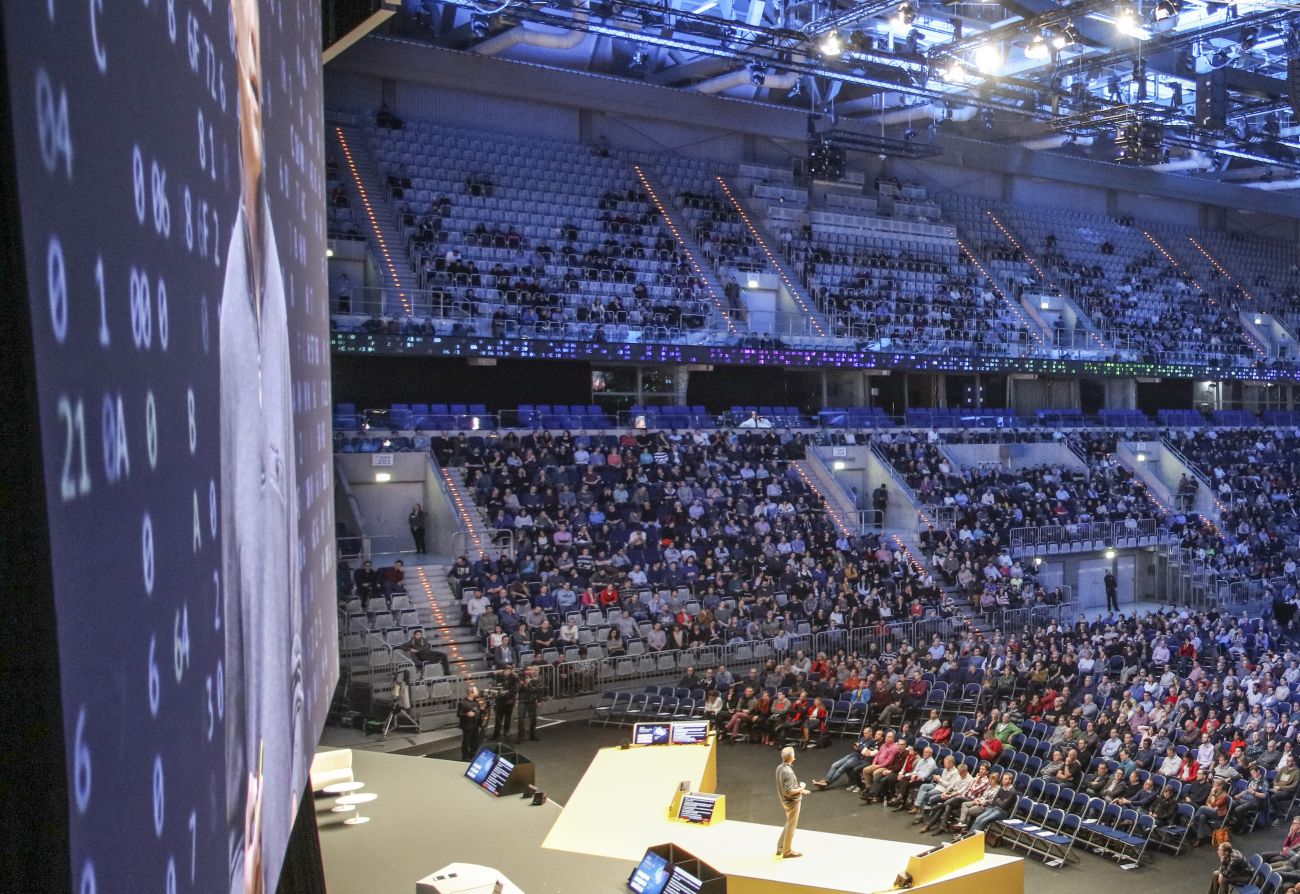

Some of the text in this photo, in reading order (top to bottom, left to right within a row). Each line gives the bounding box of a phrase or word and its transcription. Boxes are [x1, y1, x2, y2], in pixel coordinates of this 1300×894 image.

[203, 34, 217, 100] 72
[220, 61, 226, 112] 6
[208, 124, 216, 181] 1
[133, 143, 145, 224] 0
[151, 160, 170, 238] 06
[212, 209, 220, 267] 2
[47, 234, 68, 345] 0
[95, 252, 110, 348] 1
[130, 265, 152, 350] 00
[157, 276, 169, 353] 0
[58, 395, 90, 501] 21
[101, 393, 130, 483] 0A
[145, 388, 158, 470] 0
[194, 476, 217, 555] A 0
[142, 510, 155, 597] 0
[213, 568, 220, 630] 2
[148, 632, 160, 717] 6
[216, 658, 224, 721] 0
[74, 704, 91, 816] 6
[153, 753, 164, 838] 0
